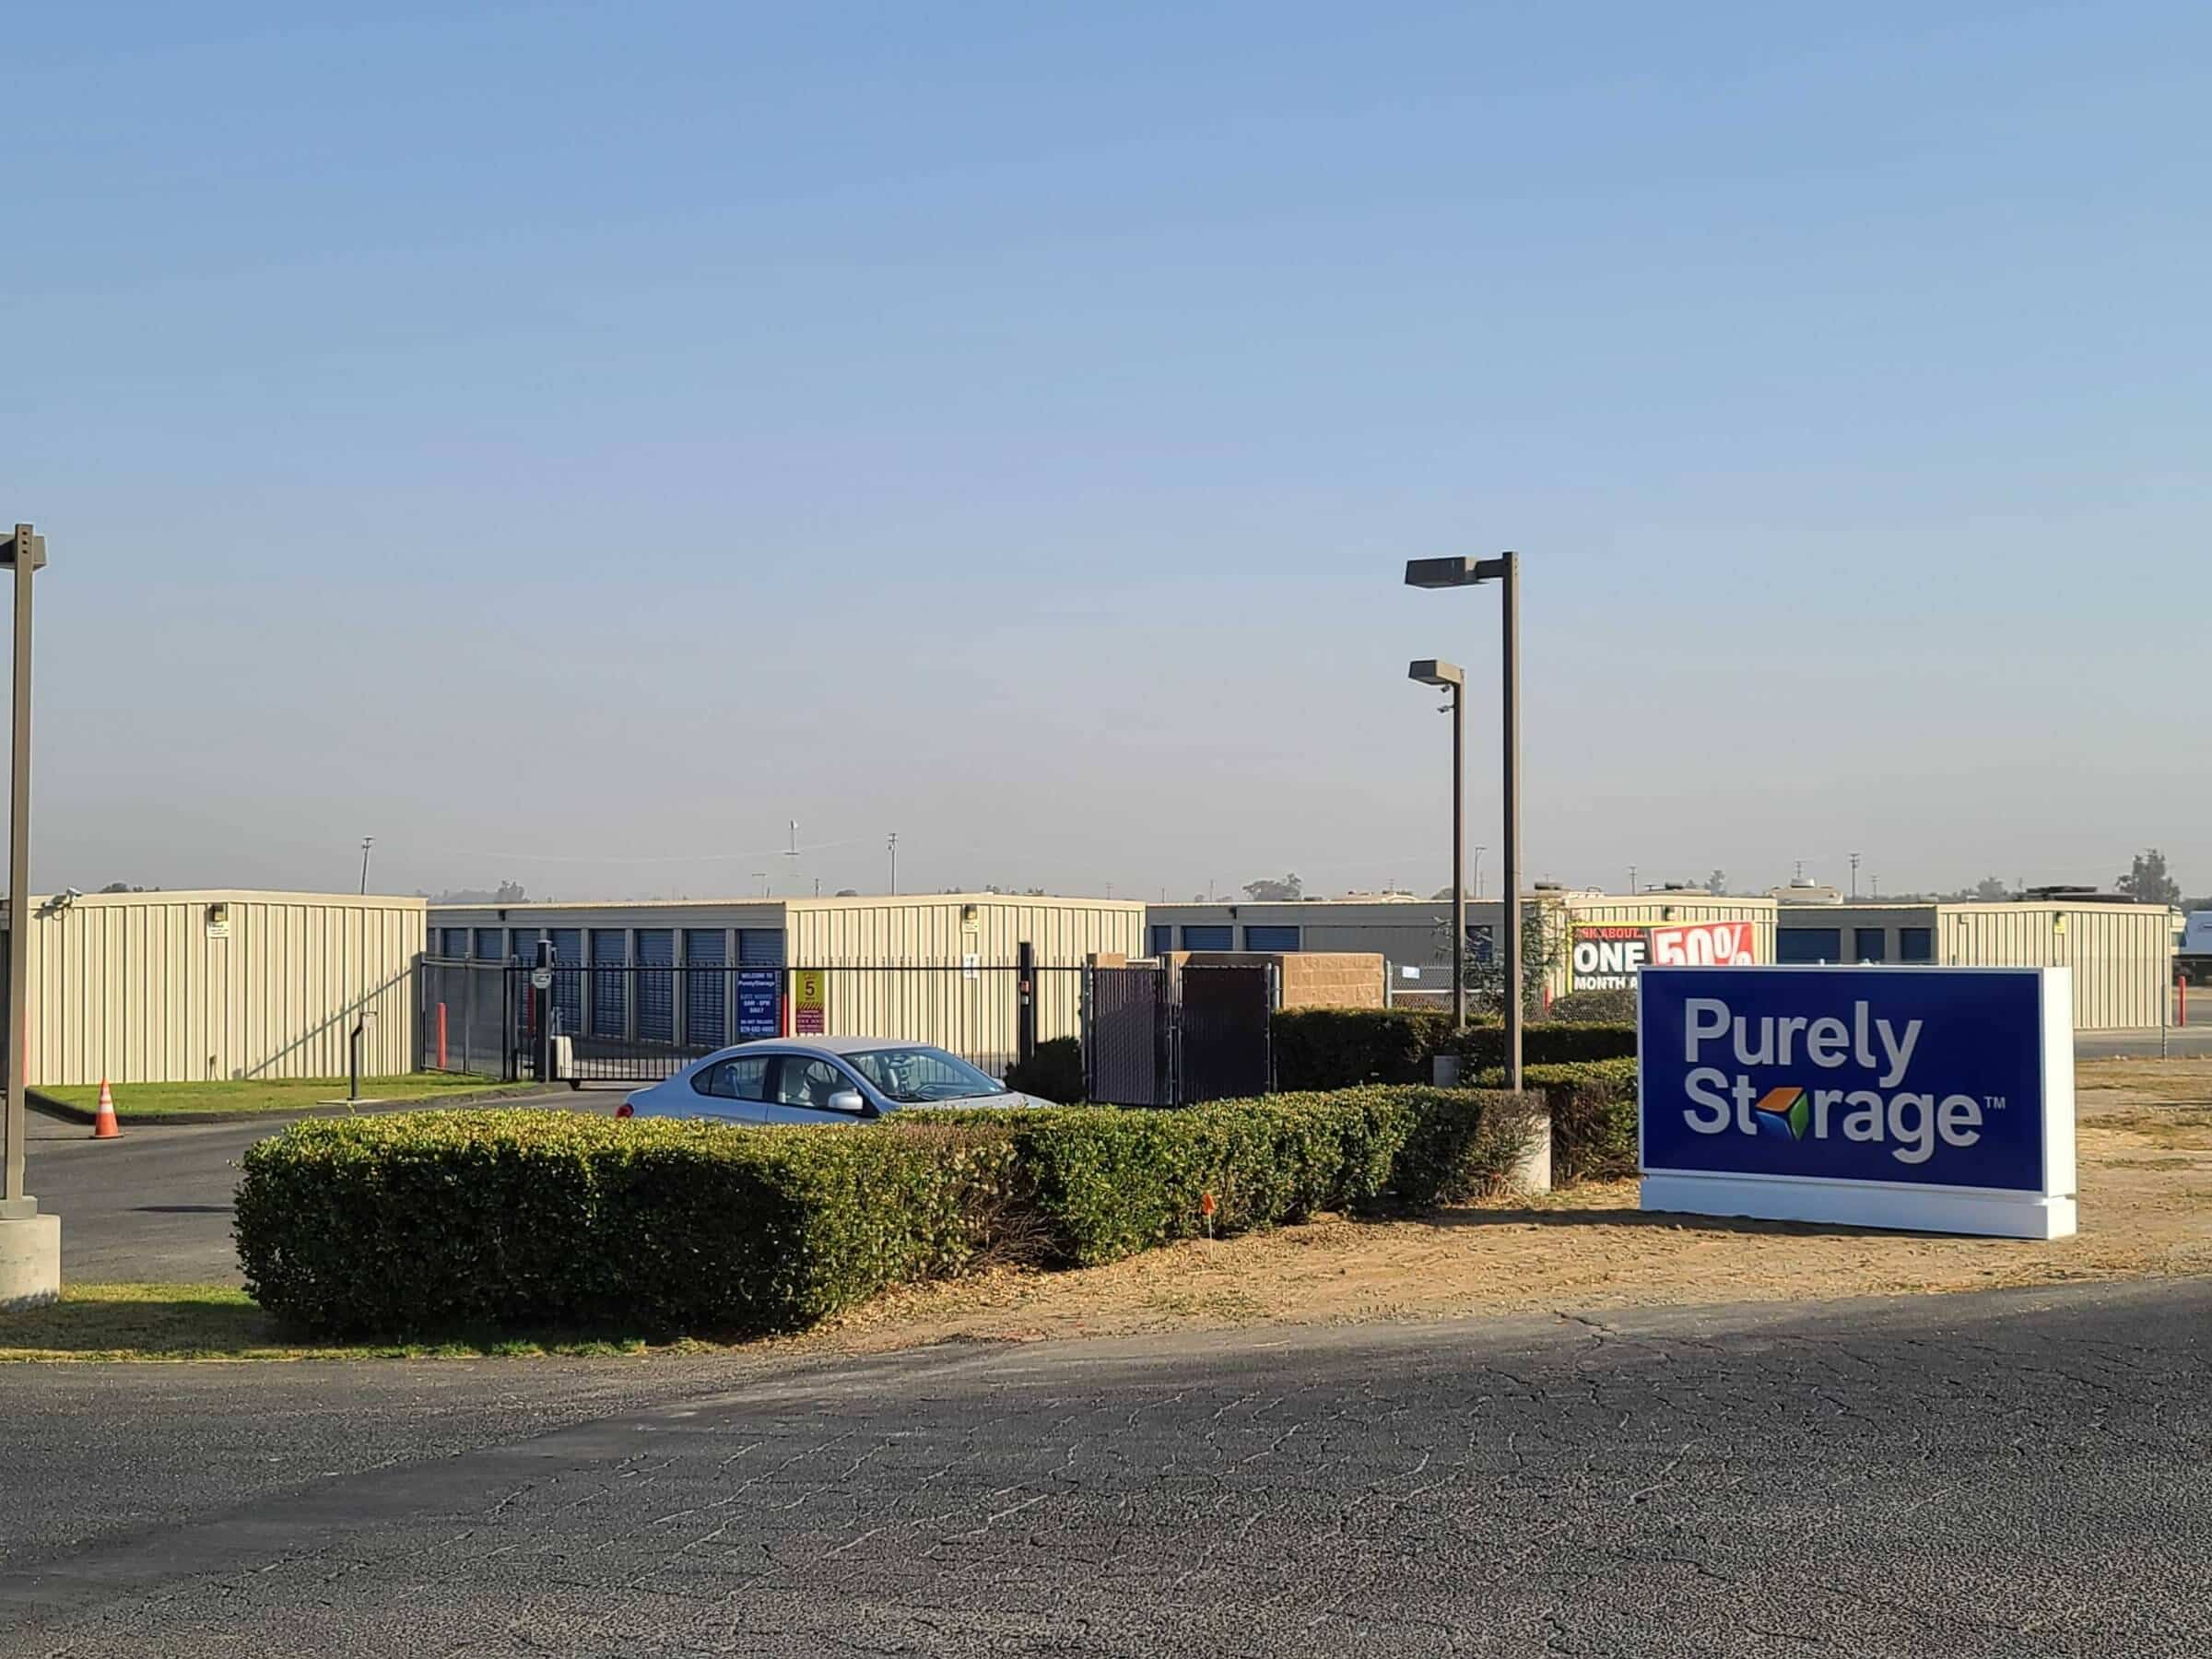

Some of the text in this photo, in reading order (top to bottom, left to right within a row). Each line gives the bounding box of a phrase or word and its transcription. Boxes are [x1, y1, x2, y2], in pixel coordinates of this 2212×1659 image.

[1575, 927, 1597, 938] SK
[1573, 941, 1645, 973] ONE
[806, 980, 815, 996] 5
[1574, 976, 1627, 991] MONTH
[1684, 997, 1924, 1088] Purely
